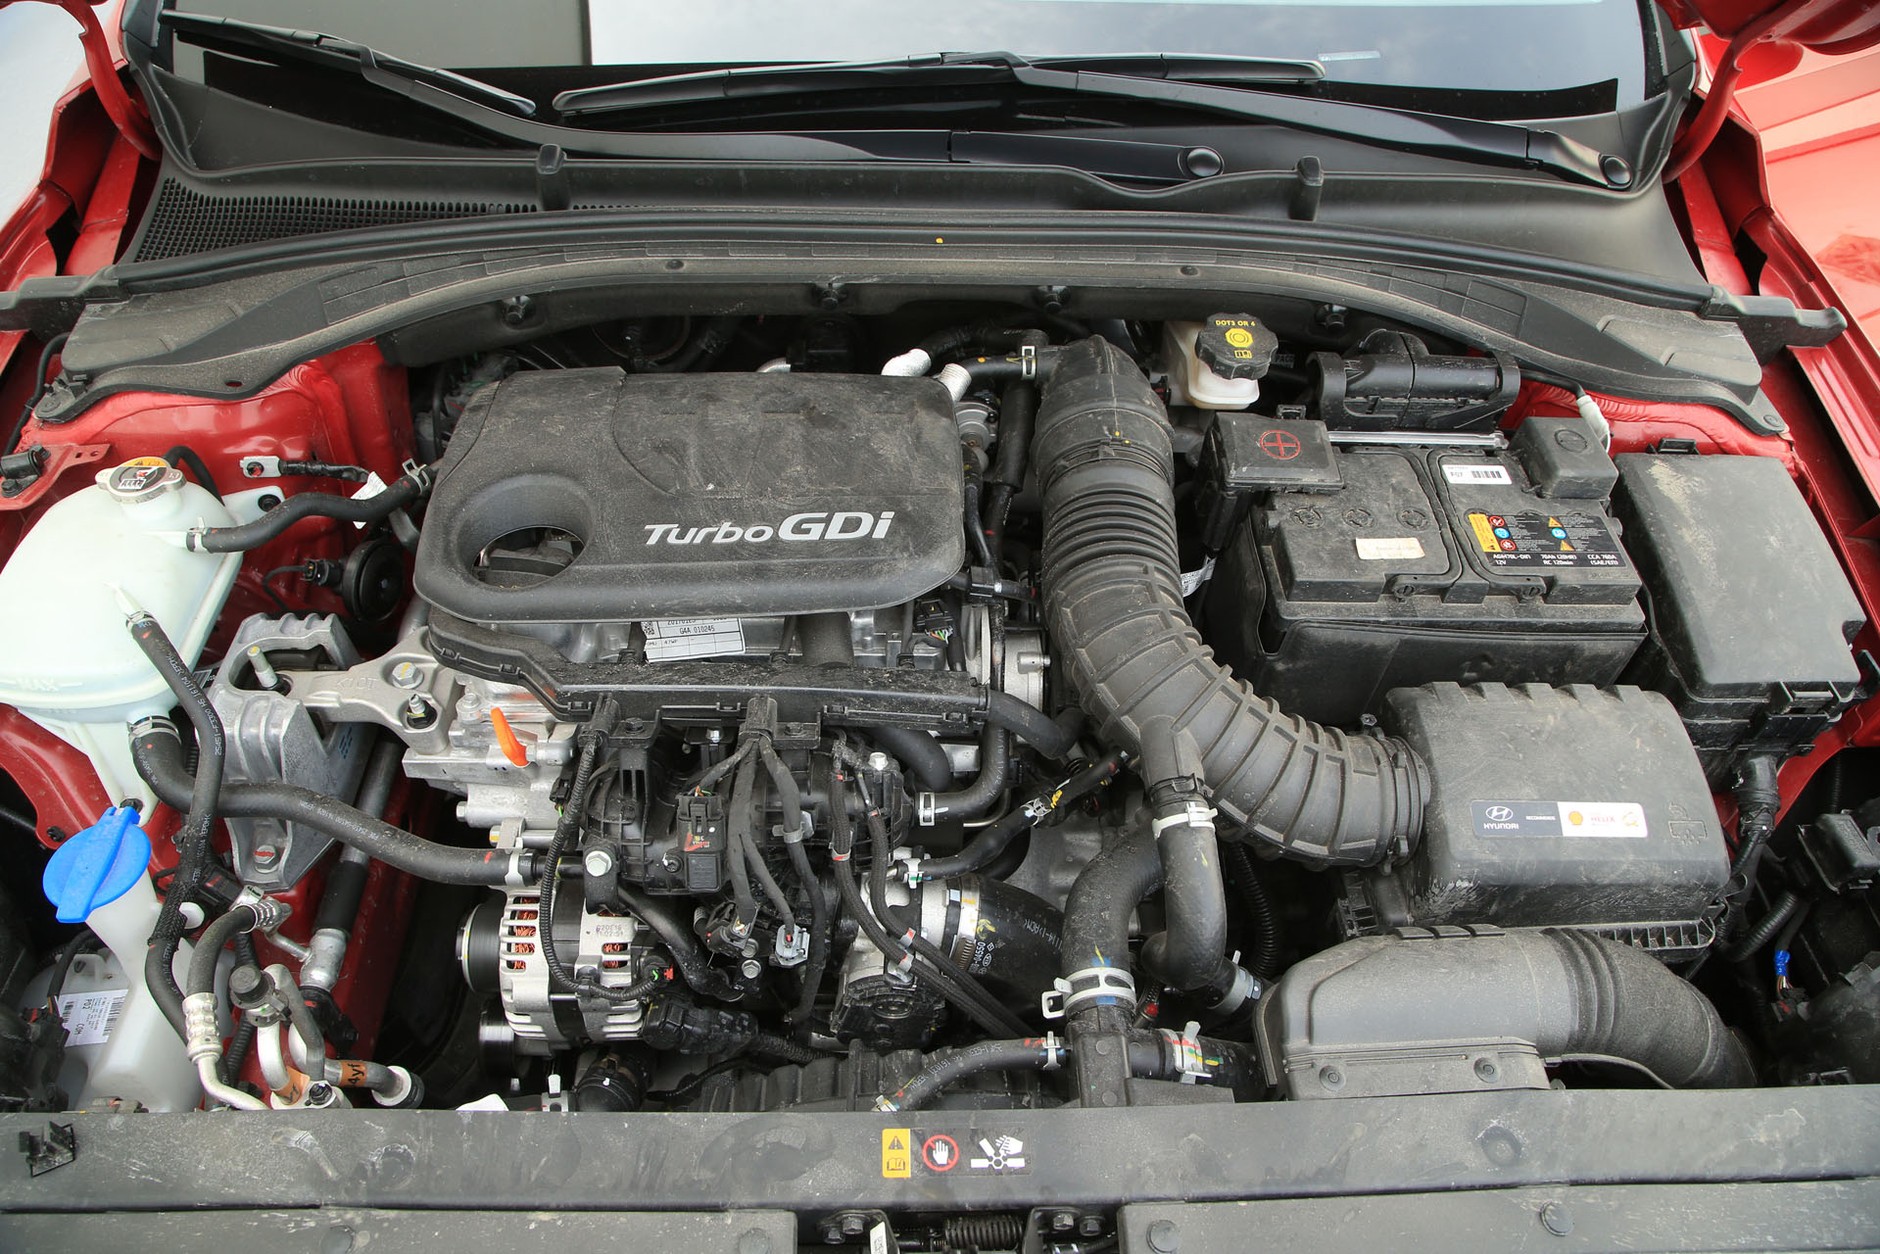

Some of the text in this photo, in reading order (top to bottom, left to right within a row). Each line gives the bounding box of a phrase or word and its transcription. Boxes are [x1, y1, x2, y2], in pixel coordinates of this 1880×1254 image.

[644, 511, 895, 545] Turbo GDi
[1483, 822, 1520, 830] HYUNDAI
